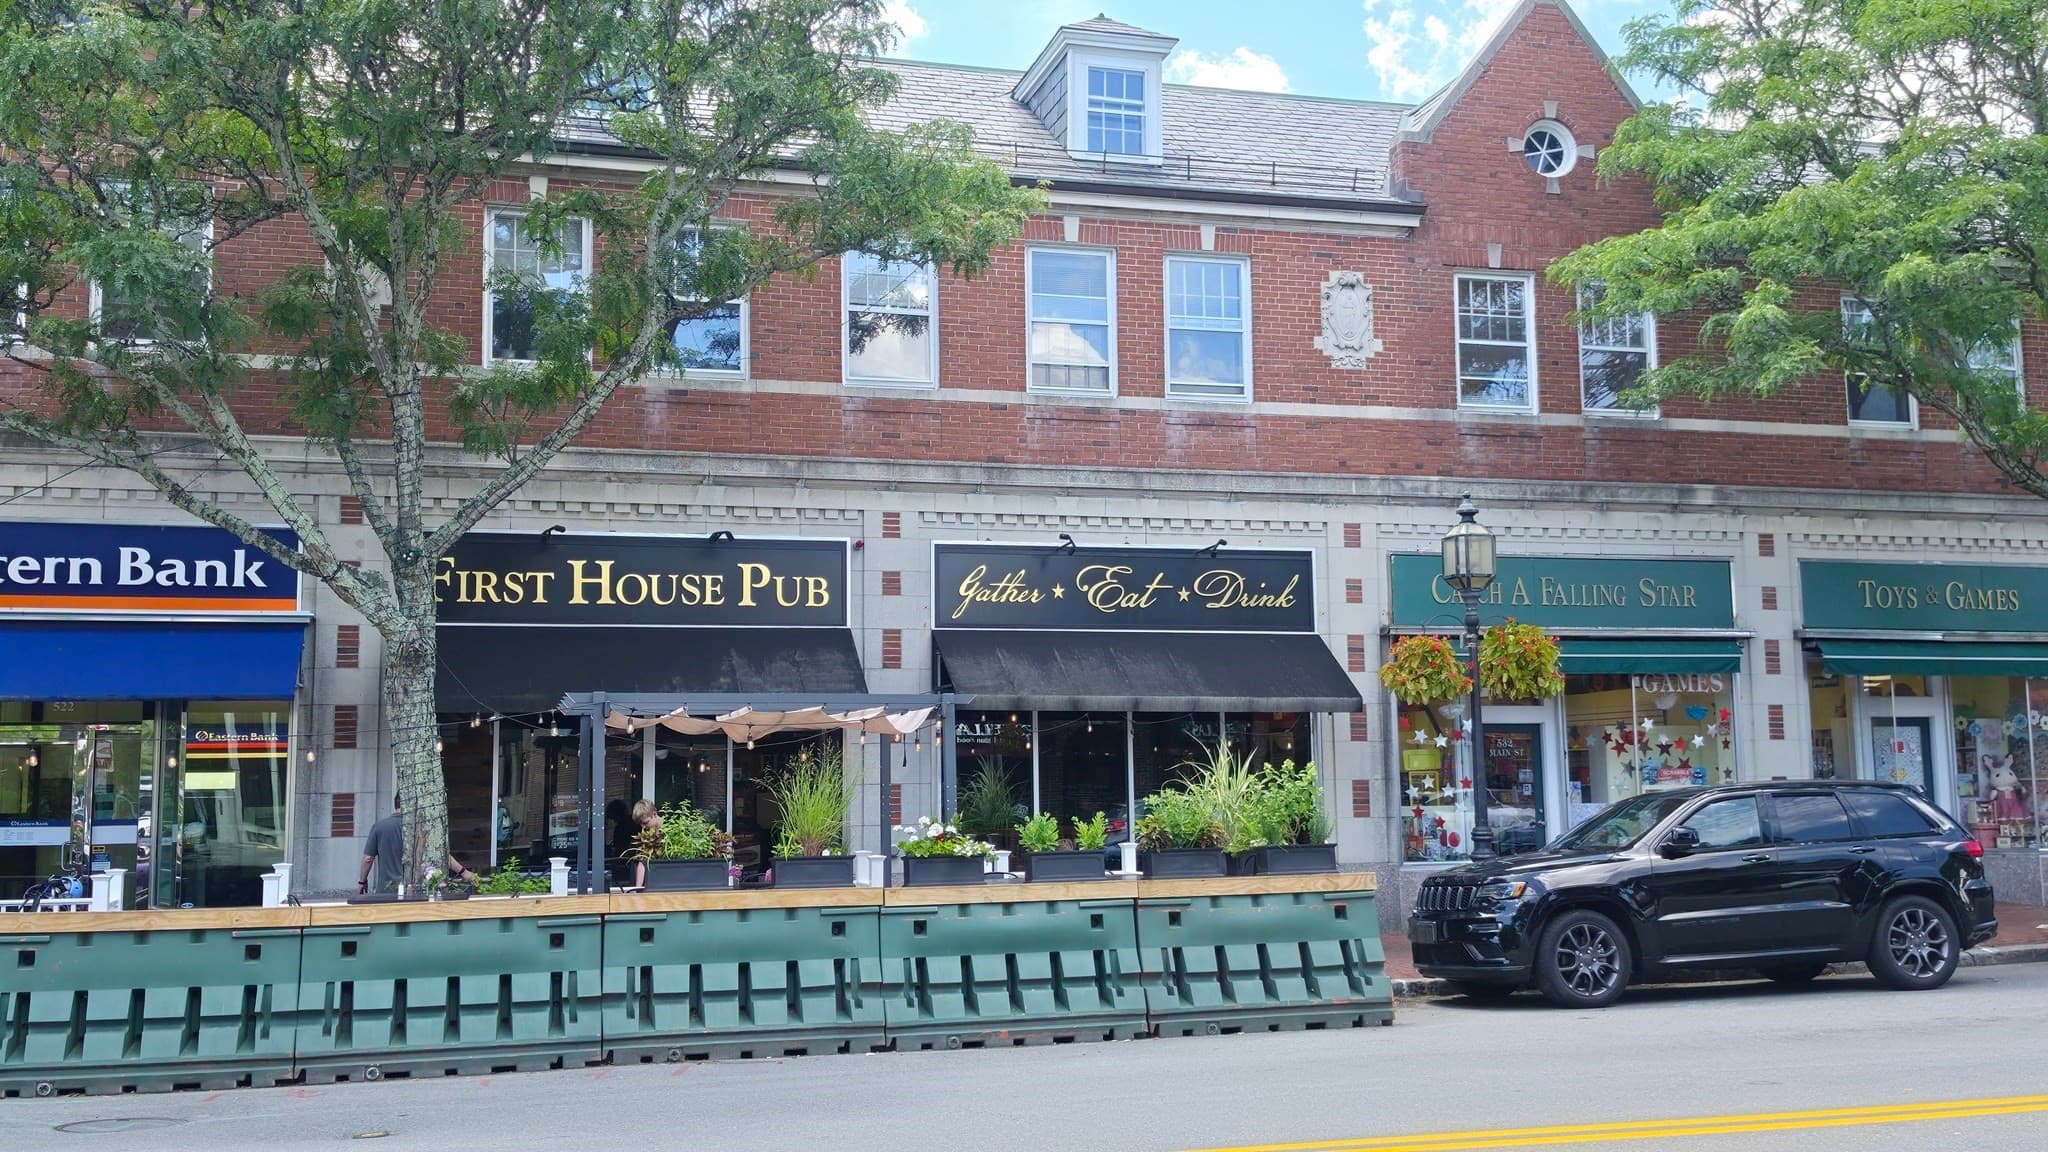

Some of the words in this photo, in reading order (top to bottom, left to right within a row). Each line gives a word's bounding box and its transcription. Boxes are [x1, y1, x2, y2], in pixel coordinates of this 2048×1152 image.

[117, 546, 268, 588] Bank
[433, 557, 555, 604] FIRST
[567, 559, 725, 606] HOUSE
[737, 563, 830, 607] PUB
[952, 564, 1047, 618] Gather
[1076, 565, 1173, 612] Eat
[1193, 569, 1300, 610] Drink
[1431, 574, 1503, 605] CACH
[1511, 577, 1532, 606] A
[1540, 576, 1627, 607] FALLING
[1639, 578, 1697, 608] STAR
[1858, 580, 1918, 609] TOYS
[1925, 585, 1939, 604] &
[1945, 581, 2019, 611] GAMES
[1642, 672, 1724, 693] GAMES
[53, 701, 75, 712] 522
[208, 732, 249, 741] Eastern
[250, 732, 279, 741] Bank
